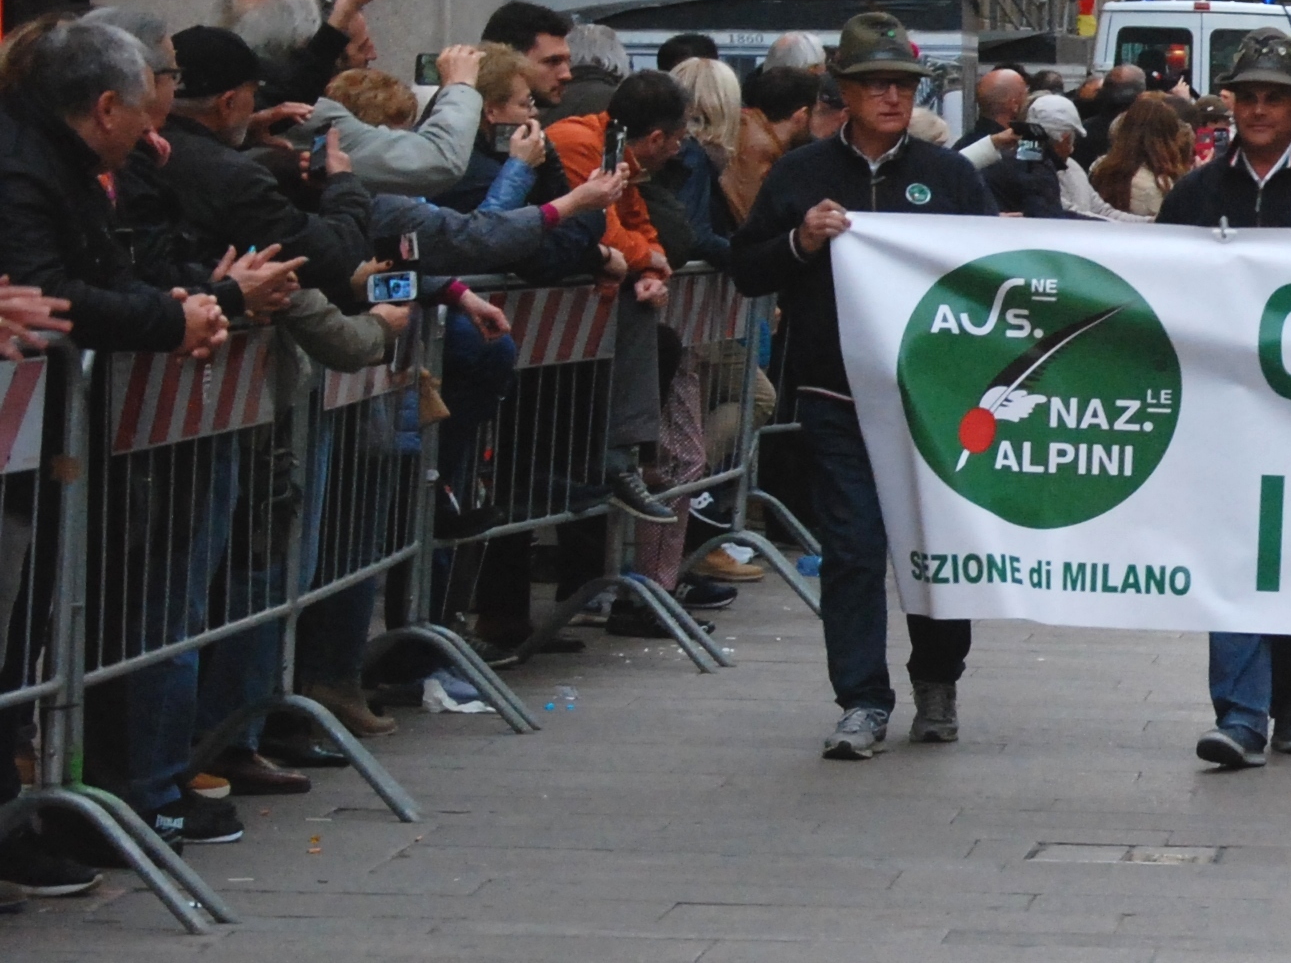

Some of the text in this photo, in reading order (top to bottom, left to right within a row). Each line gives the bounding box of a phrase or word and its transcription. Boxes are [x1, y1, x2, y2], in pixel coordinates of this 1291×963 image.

[994, 440, 1134, 476] ALPINI
[910, 550, 1192, 596] SEZIONE di MILANO
